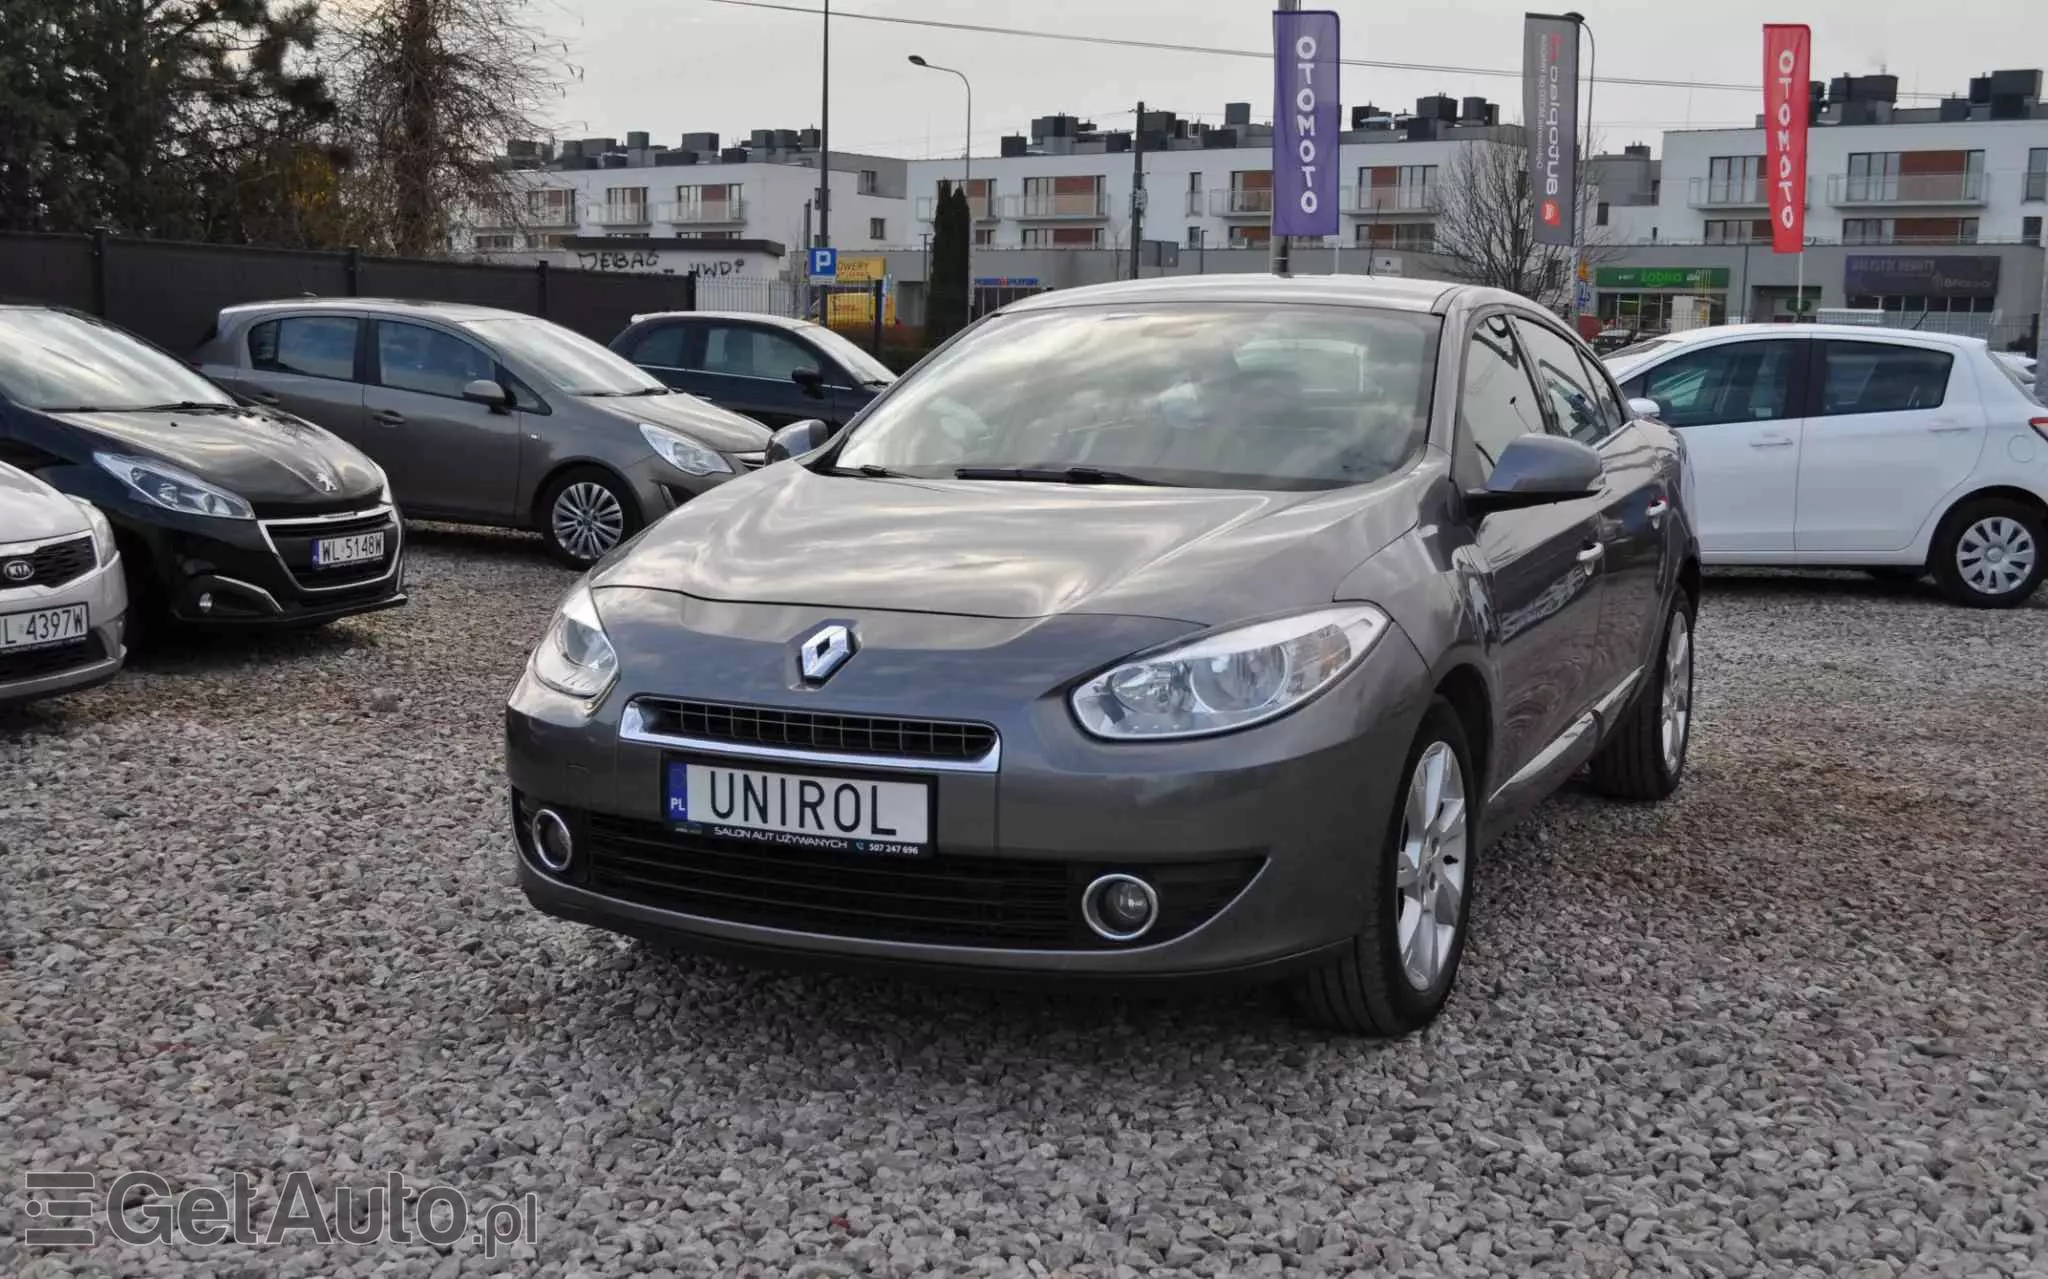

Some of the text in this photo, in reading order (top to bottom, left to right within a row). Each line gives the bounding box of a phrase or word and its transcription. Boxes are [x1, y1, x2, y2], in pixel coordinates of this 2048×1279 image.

[1296, 36, 1318, 214] OTOMOTO
[1778, 50, 1795, 229] OTOMOTO
[815, 250, 832, 273] P
[322, 534, 383, 562] WL 5148W
[0, 617, 17, 647] L
[26, 607, 84, 641] 4397W
[670, 797, 686, 812] PL
[710, 770, 897, 837] UNIROL
[714, 826, 751, 839] SALON
[752, 831, 775, 842] AUT
[776, 833, 848, 849] UŻYWANYCH
